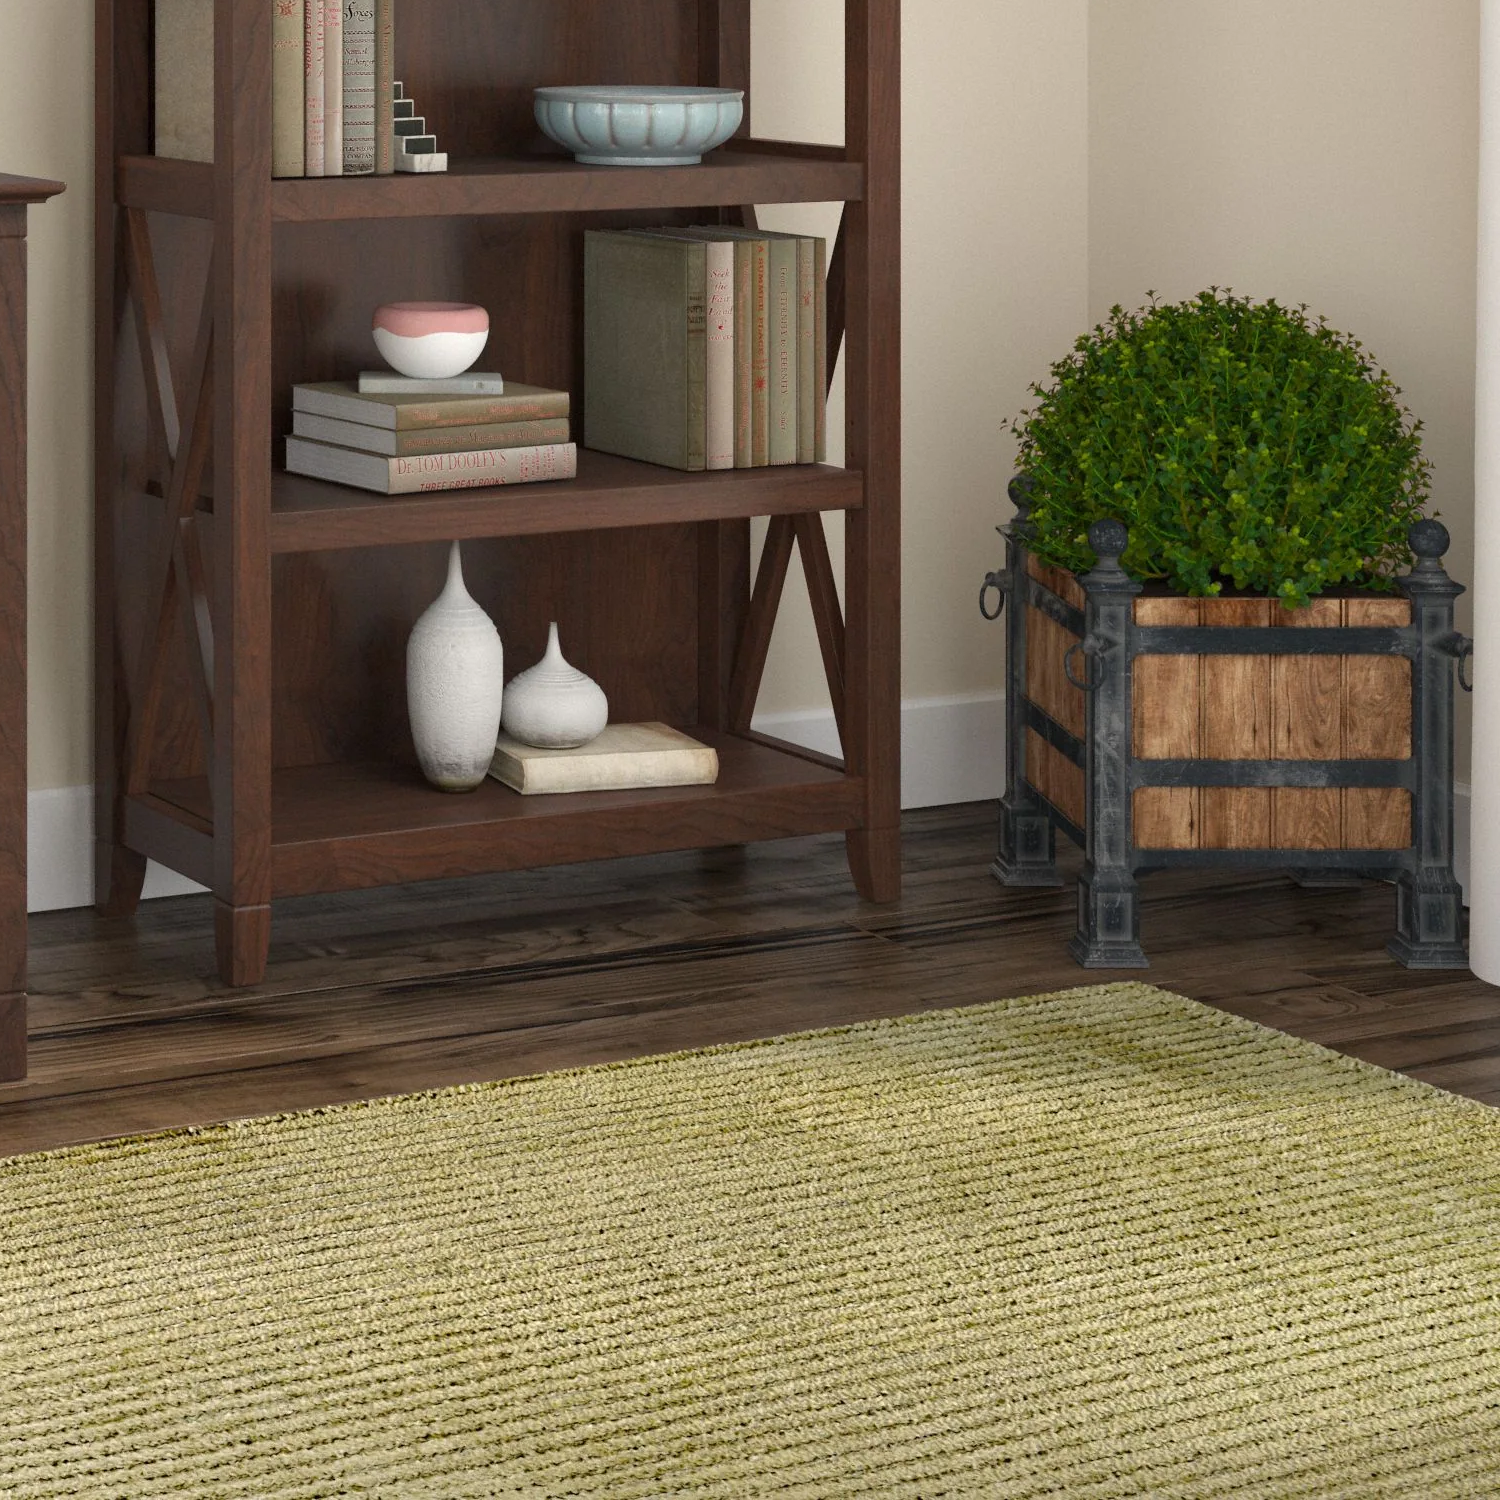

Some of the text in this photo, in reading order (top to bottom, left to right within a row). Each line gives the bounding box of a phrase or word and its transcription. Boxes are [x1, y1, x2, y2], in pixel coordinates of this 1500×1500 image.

[714, 281, 728, 290] the
[757, 257, 765, 312] SUMMER
[780, 291, 788, 336] ETERNITY
[757, 317, 765, 356] PLACE
[780, 351, 788, 394] ETERNITY
[397, 458, 414, 475] Dr.
[416, 455, 444, 474] TOM
[449, 451, 507, 471] DOOLEY'S
[420, 476, 506, 492] THREE GREAT BOOKS
